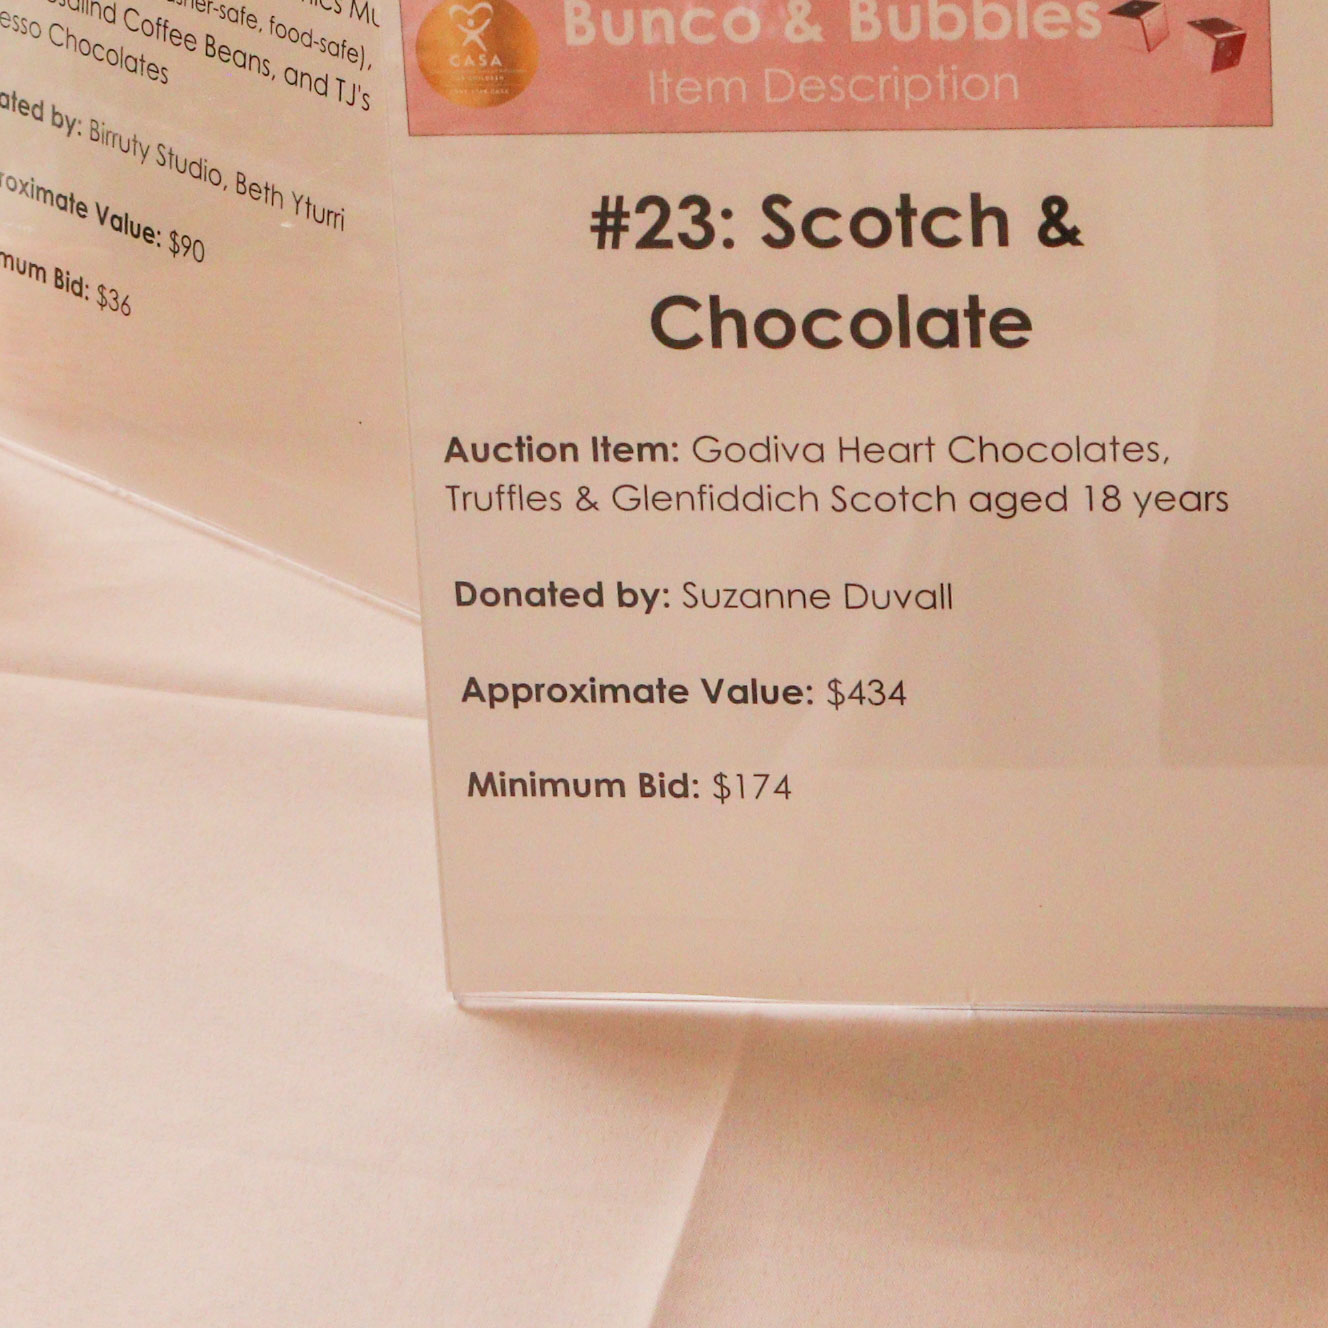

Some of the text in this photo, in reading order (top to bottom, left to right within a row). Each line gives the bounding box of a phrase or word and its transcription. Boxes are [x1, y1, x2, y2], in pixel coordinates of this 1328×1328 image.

[269, 18, 373, 72] food-safe),
[786, 0, 824, 43] &
[49, 24, 170, 86] Chocolates
[123, 8, 197, 52] Coffee
[205, 35, 276, 82] Beans,
[284, 63, 328, 98] and
[336, 79, 371, 112] TJ's
[449, 53, 503, 68] CASA
[648, 63, 1019, 110] Item Description
[51, 105, 83, 138] by:
[89, 118, 150, 165] Birruty
[156, 143, 228, 192] Studio,
[236, 171, 284, 209] Beth
[291, 191, 345, 232] Yturri
[95, 201, 162, 248] Value:
[168, 229, 205, 263] $90
[590, 192, 1085, 251] #23: Scotch &
[54, 268, 90, 301] Bid:
[96, 283, 132, 318] $36
[650, 294, 1033, 350] Chocolate
[443, 435, 1171, 468] Auction Item: Godiva Heart Chocolates,
[444, 482, 1230, 521] Truffles & Glenfiddich Scotch aged 18 years
[454, 580, 954, 617] Donated by: Suzanne Duvall
[460, 676, 907, 712] Approximate Value: $434
[467, 769, 793, 804] Minimum Bid: $174
